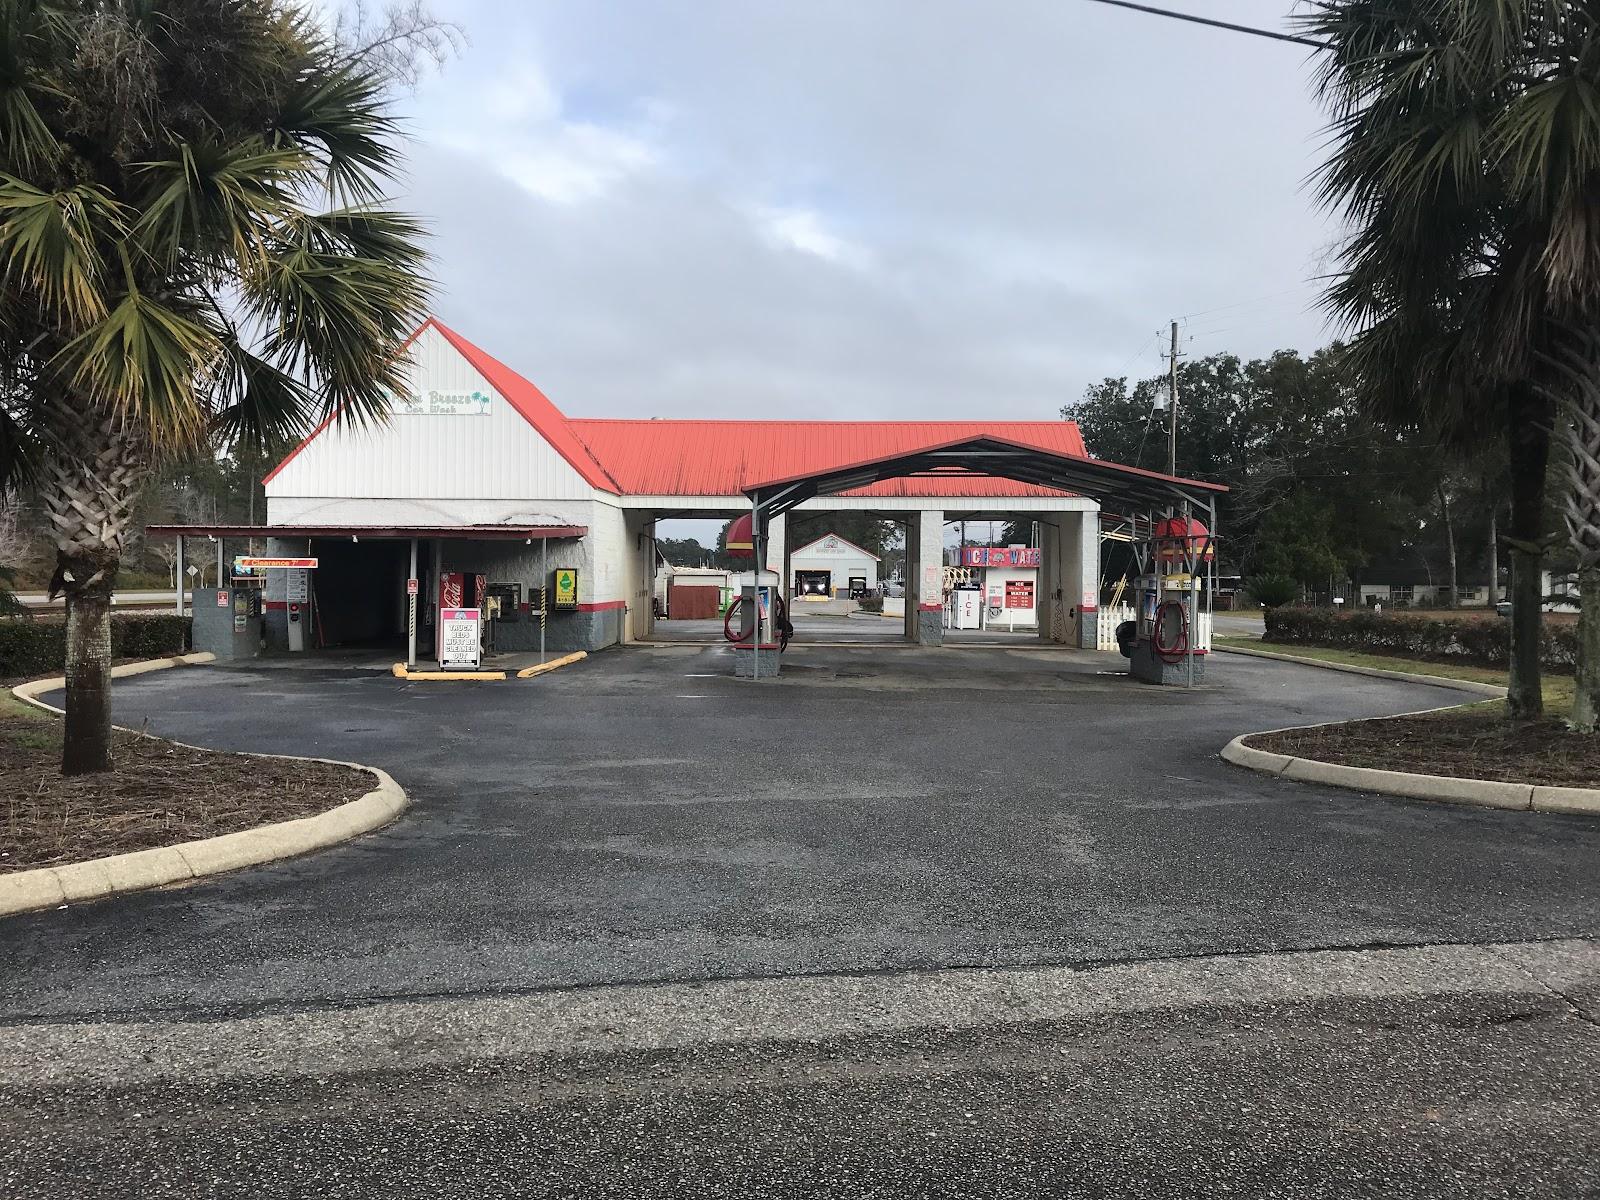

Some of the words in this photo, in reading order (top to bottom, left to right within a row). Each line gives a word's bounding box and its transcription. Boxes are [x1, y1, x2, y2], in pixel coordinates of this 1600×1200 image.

[428, 391, 471, 404] Breeze
[430, 405, 456, 413] Wash
[966, 550, 988, 564] ICE
[1010, 550, 1040, 564] WATE
